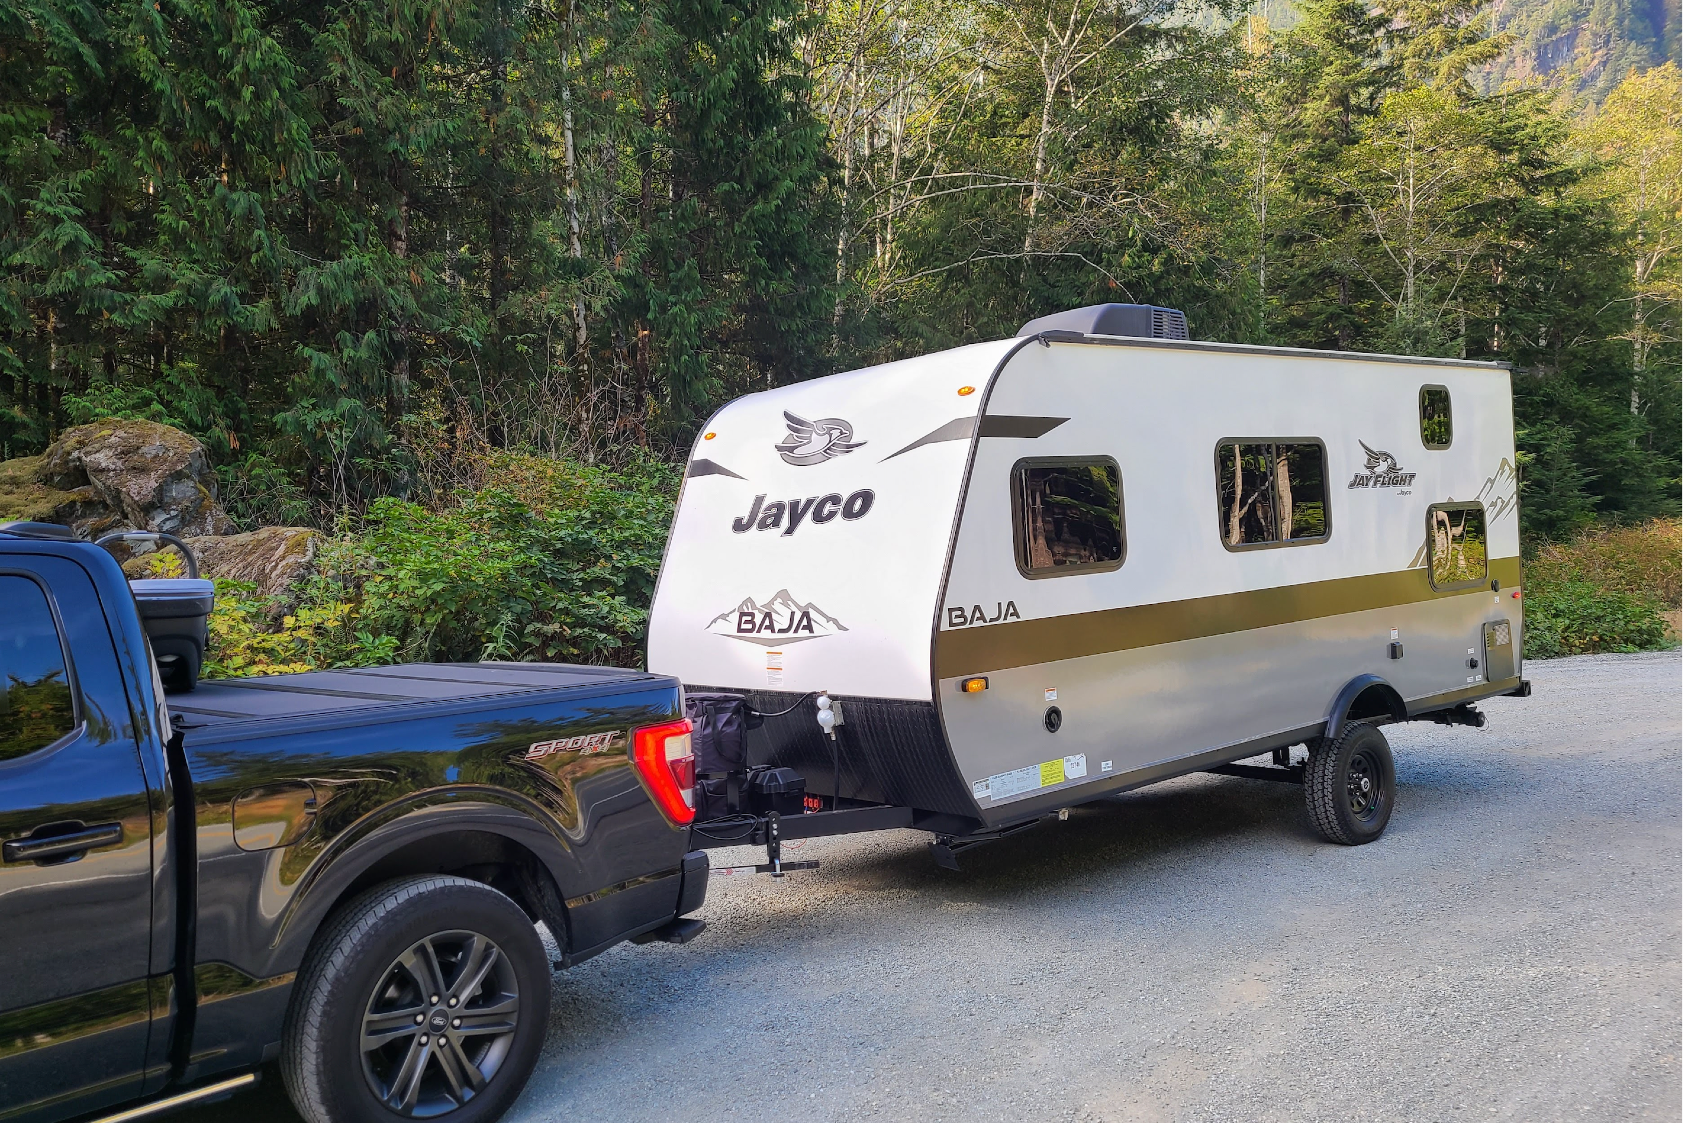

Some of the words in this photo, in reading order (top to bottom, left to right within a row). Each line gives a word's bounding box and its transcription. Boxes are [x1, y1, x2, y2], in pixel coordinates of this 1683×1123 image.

[1348, 473, 1373, 489] JAY
[1371, 472, 1416, 488] FLIGHT
[732, 489, 875, 537] Jayco
[736, 611, 814, 634] BAJA
[947, 600, 1021, 627] BAJA
[524, 730, 620, 760] SPORT
